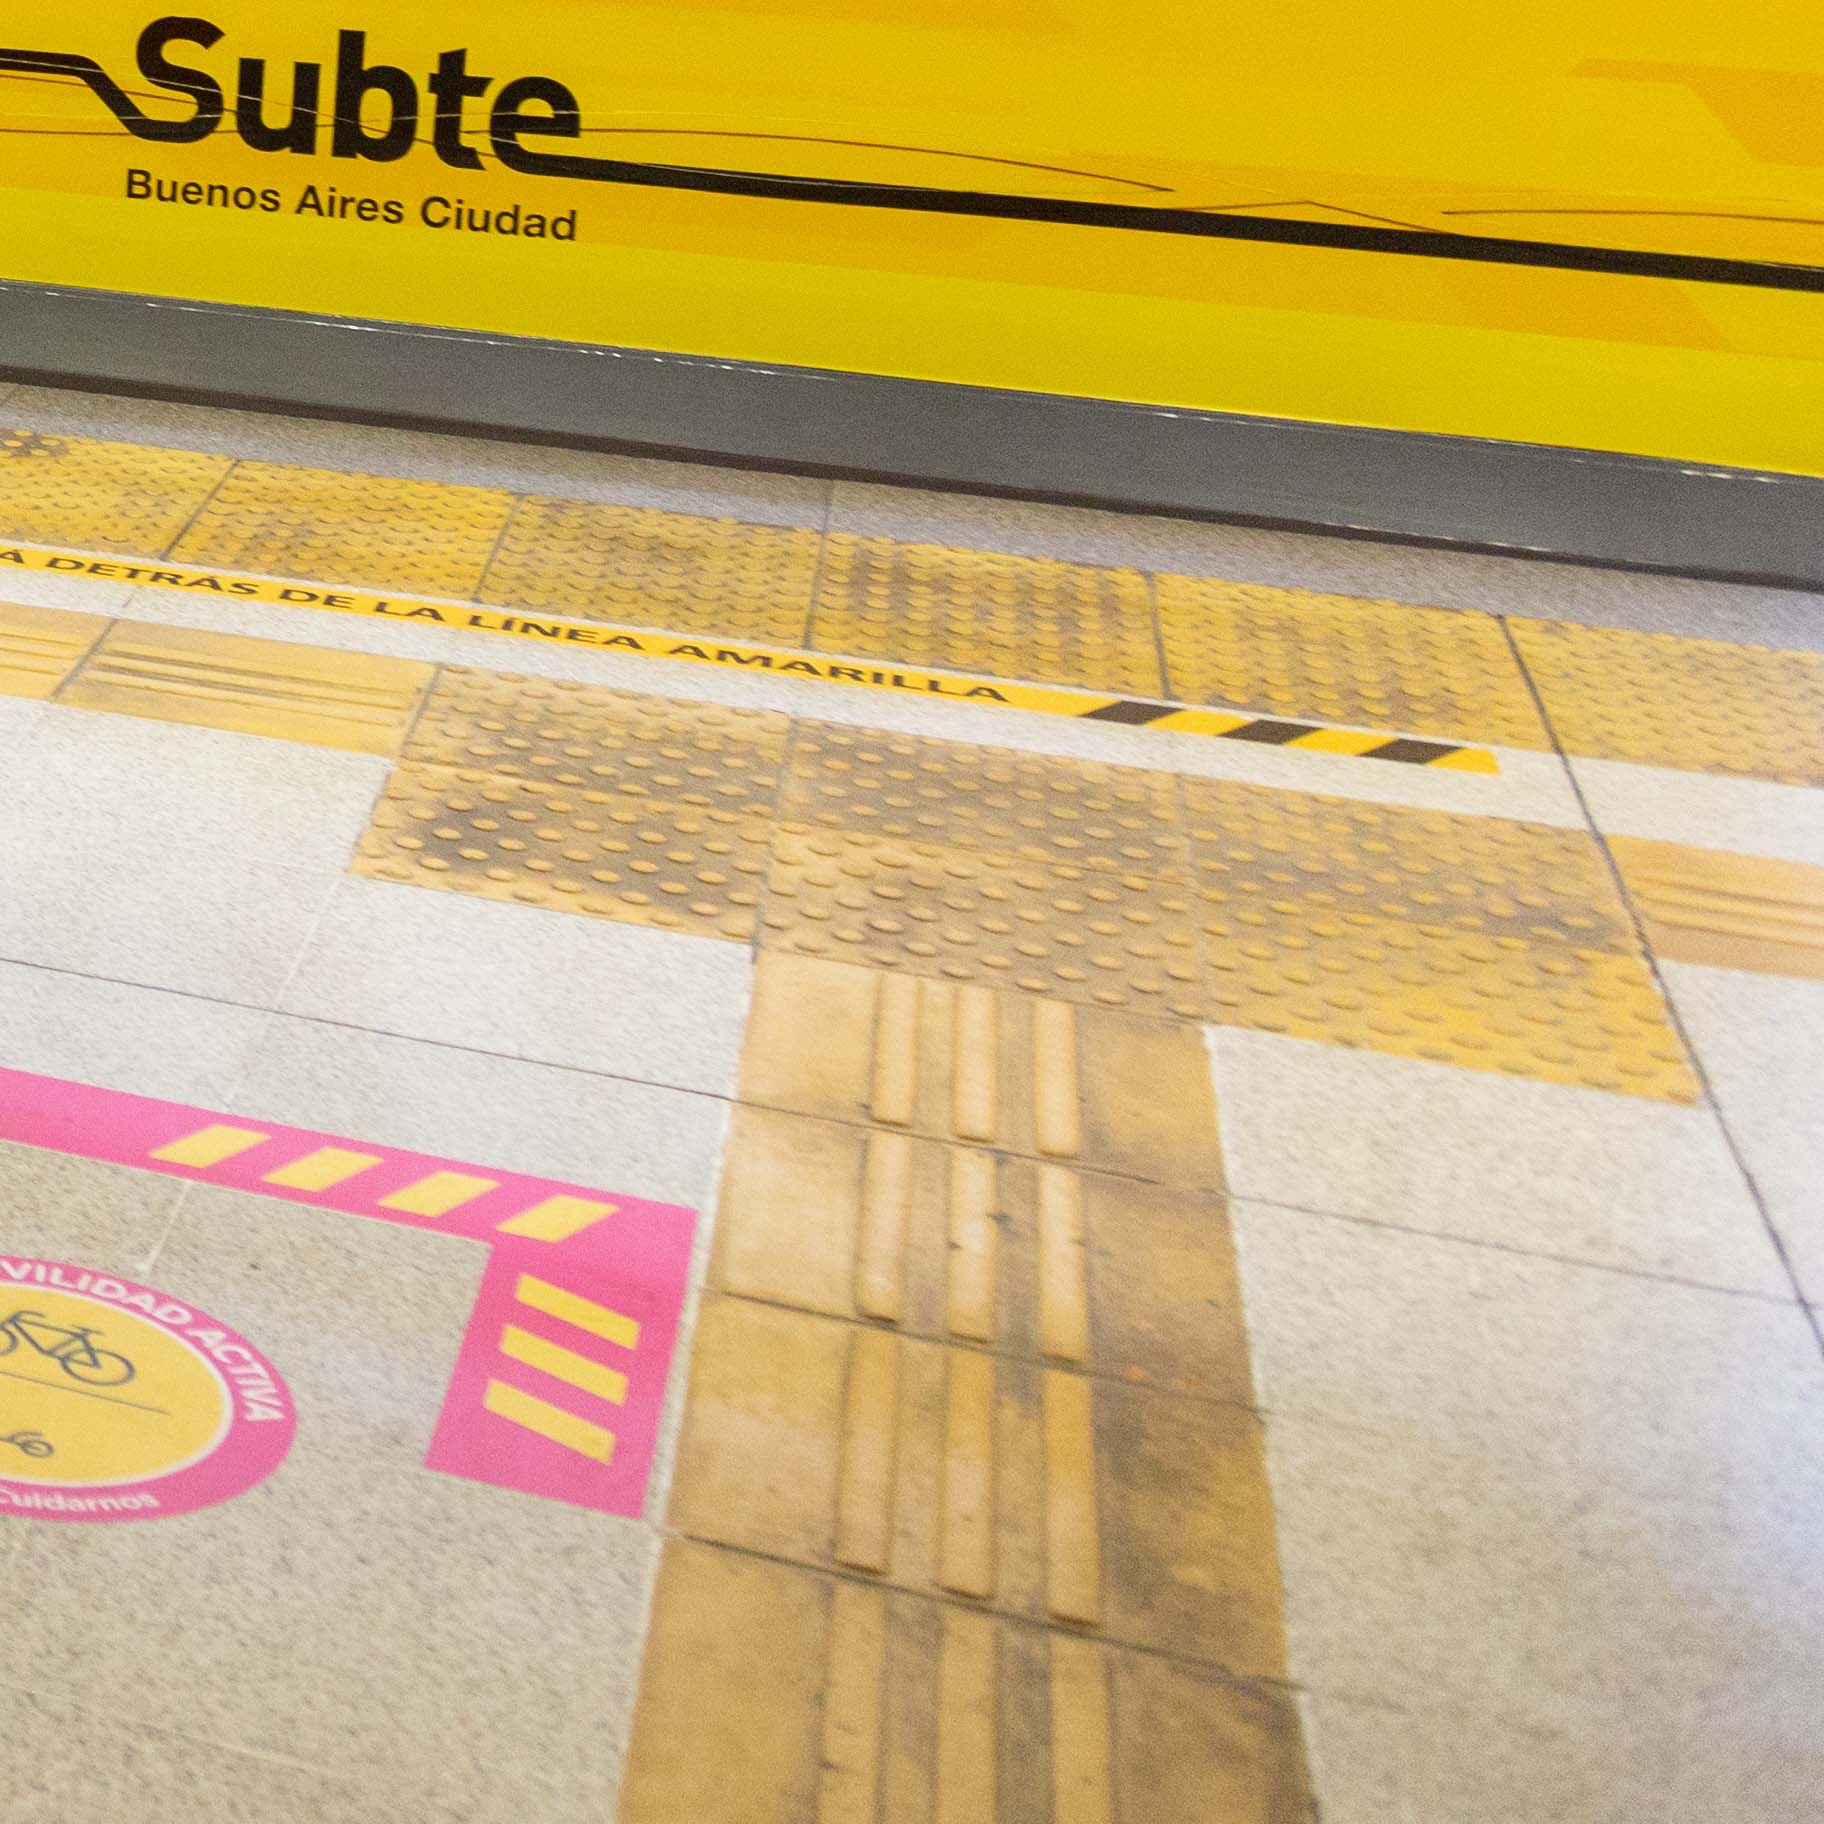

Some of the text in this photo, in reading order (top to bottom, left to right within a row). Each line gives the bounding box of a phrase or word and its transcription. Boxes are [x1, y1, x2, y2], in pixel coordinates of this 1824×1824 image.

[132, 16, 582, 176] Subte
[125, 168, 577, 242] Buenos Aires Ciudad
[45, 557, 260, 596] DETRÁS
[279, 588, 354, 609] DE
[374, 601, 446, 622] LA
[467, 614, 645, 651] LÍNEA
[668, 643, 1011, 703] AMARILLA
[186, 1327, 286, 1423] ACTIVA
